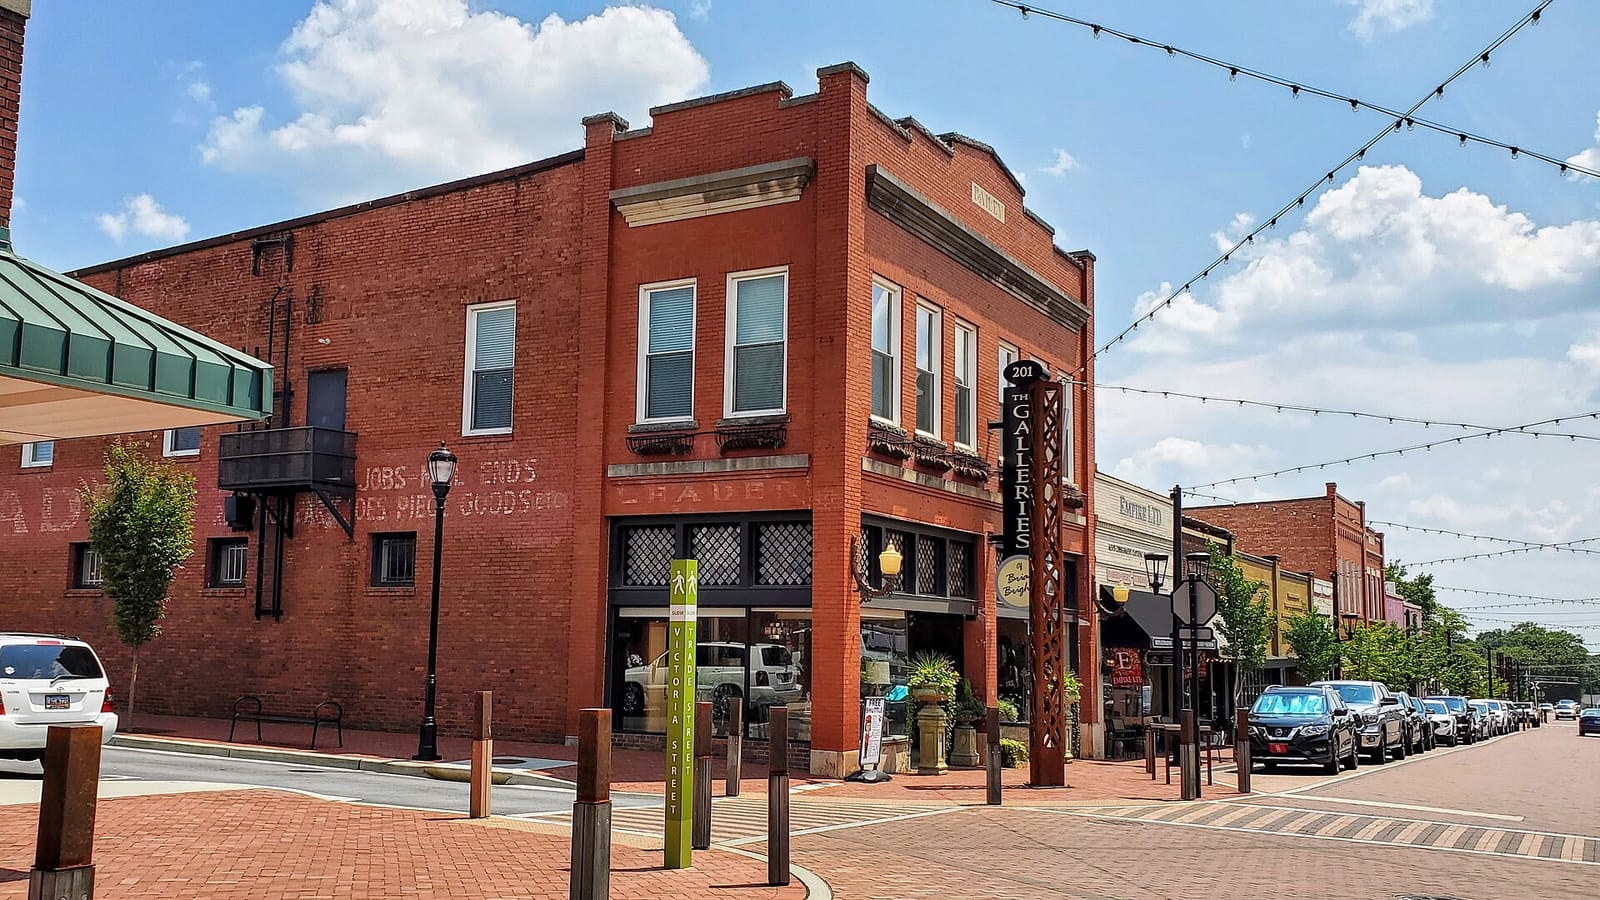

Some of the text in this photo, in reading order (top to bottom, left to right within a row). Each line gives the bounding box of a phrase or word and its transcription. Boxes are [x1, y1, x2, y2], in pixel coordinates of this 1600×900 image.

[1012, 366, 1033, 378] 201
[1013, 404, 1030, 549] GALLERIES
[670, 627, 681, 814] VICTORIA STREET
